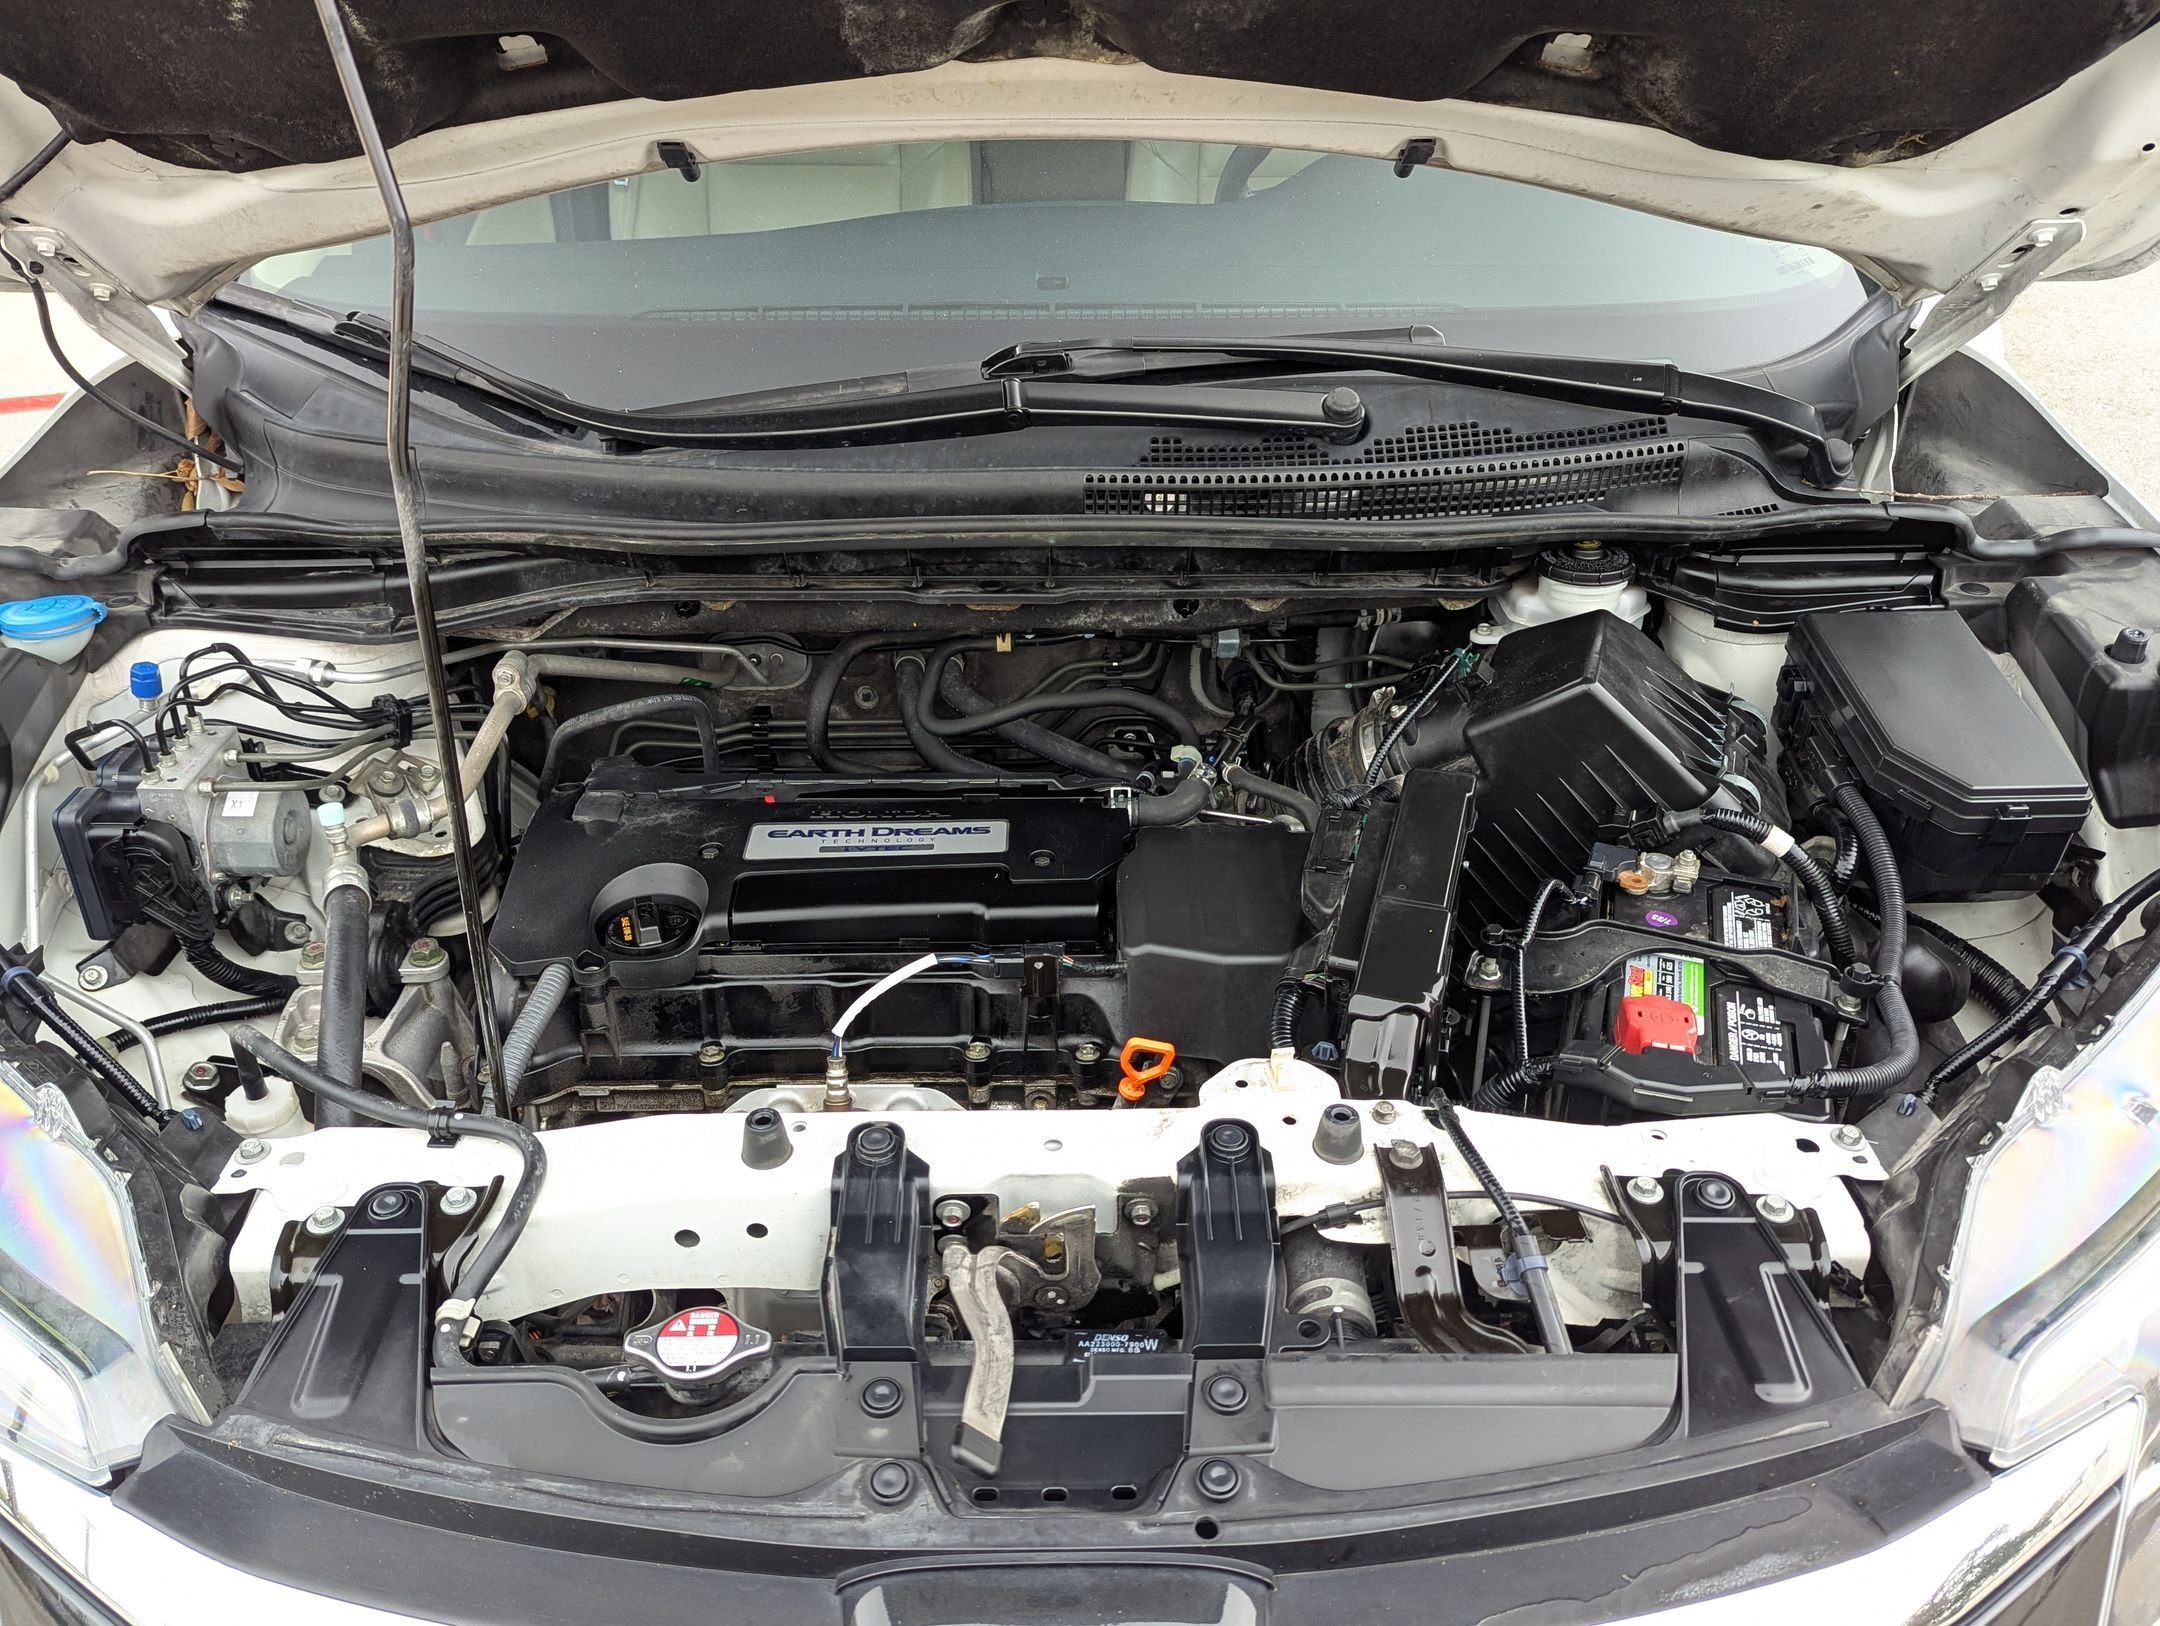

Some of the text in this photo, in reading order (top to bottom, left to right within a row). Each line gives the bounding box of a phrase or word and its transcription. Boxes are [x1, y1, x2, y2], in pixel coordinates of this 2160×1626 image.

[767, 826, 991, 839] EARTH DREAMS
[821, 837, 936, 845] TECHNOLOGY
[621, 917, 631, 927] SAE
[1651, 913, 1671, 925] 7/23
[1628, 965, 1644, 998] verStart
[1726, 1001, 1738, 1027] POISON
[1728, 1032, 1740, 1062] DANGER
[1093, 1333, 1130, 1342] DENSO
